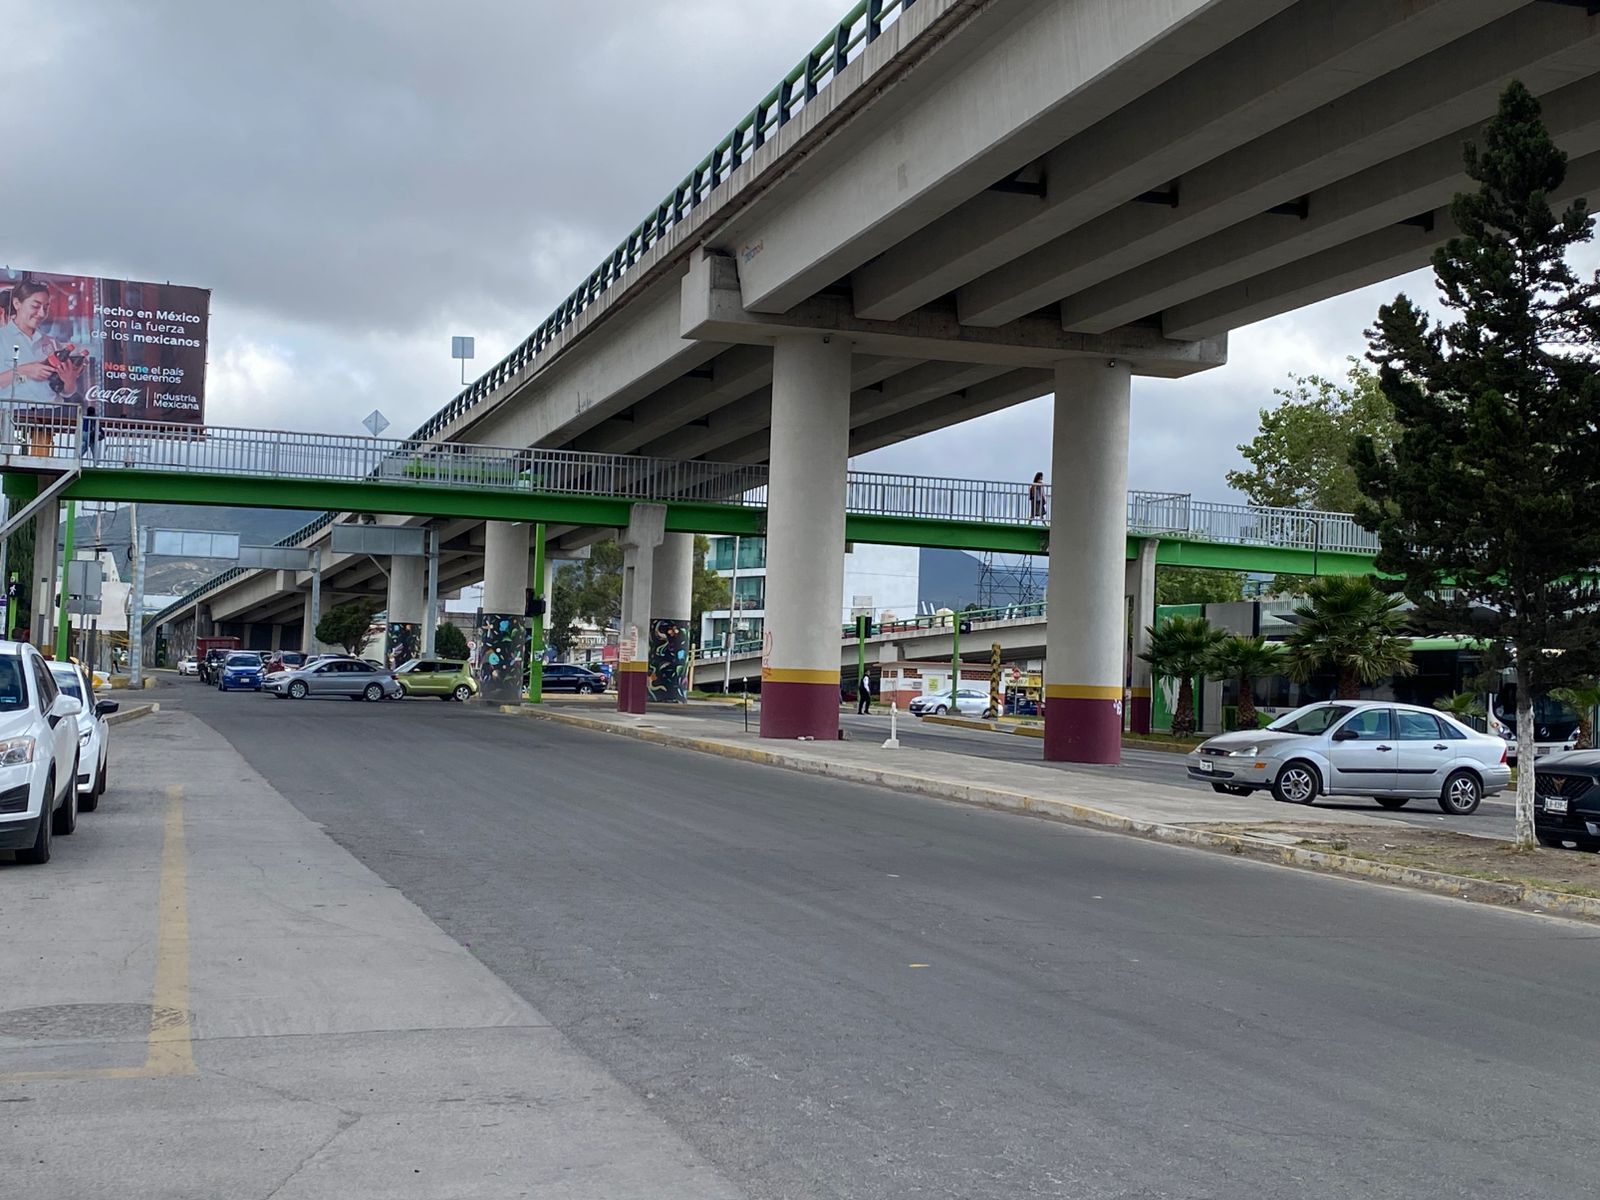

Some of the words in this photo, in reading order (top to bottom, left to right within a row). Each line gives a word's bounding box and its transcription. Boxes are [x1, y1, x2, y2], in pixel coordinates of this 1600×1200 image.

[93, 304, 133, 317] Hecho
[137, 310, 153, 319] en
[156, 310, 200, 323] México
[104, 319, 127, 329] con
[131, 320, 142, 330] la
[146, 321, 185, 334] fuerza
[91, 329, 107, 339] de
[111, 330, 130, 341] los
[133, 334, 200, 348] mexicanos
[104, 362, 126, 372] Nos
[128, 365, 148, 374] une
[151, 365, 161, 375] el
[162, 367, 184, 378] país
[106, 372, 127, 380] que
[128, 373, 181, 383] queremos
[86, 385, 142, 405] Coca-Cola
[153, 392, 197, 403] Industria
[153, 400, 200, 411] Mexicana
